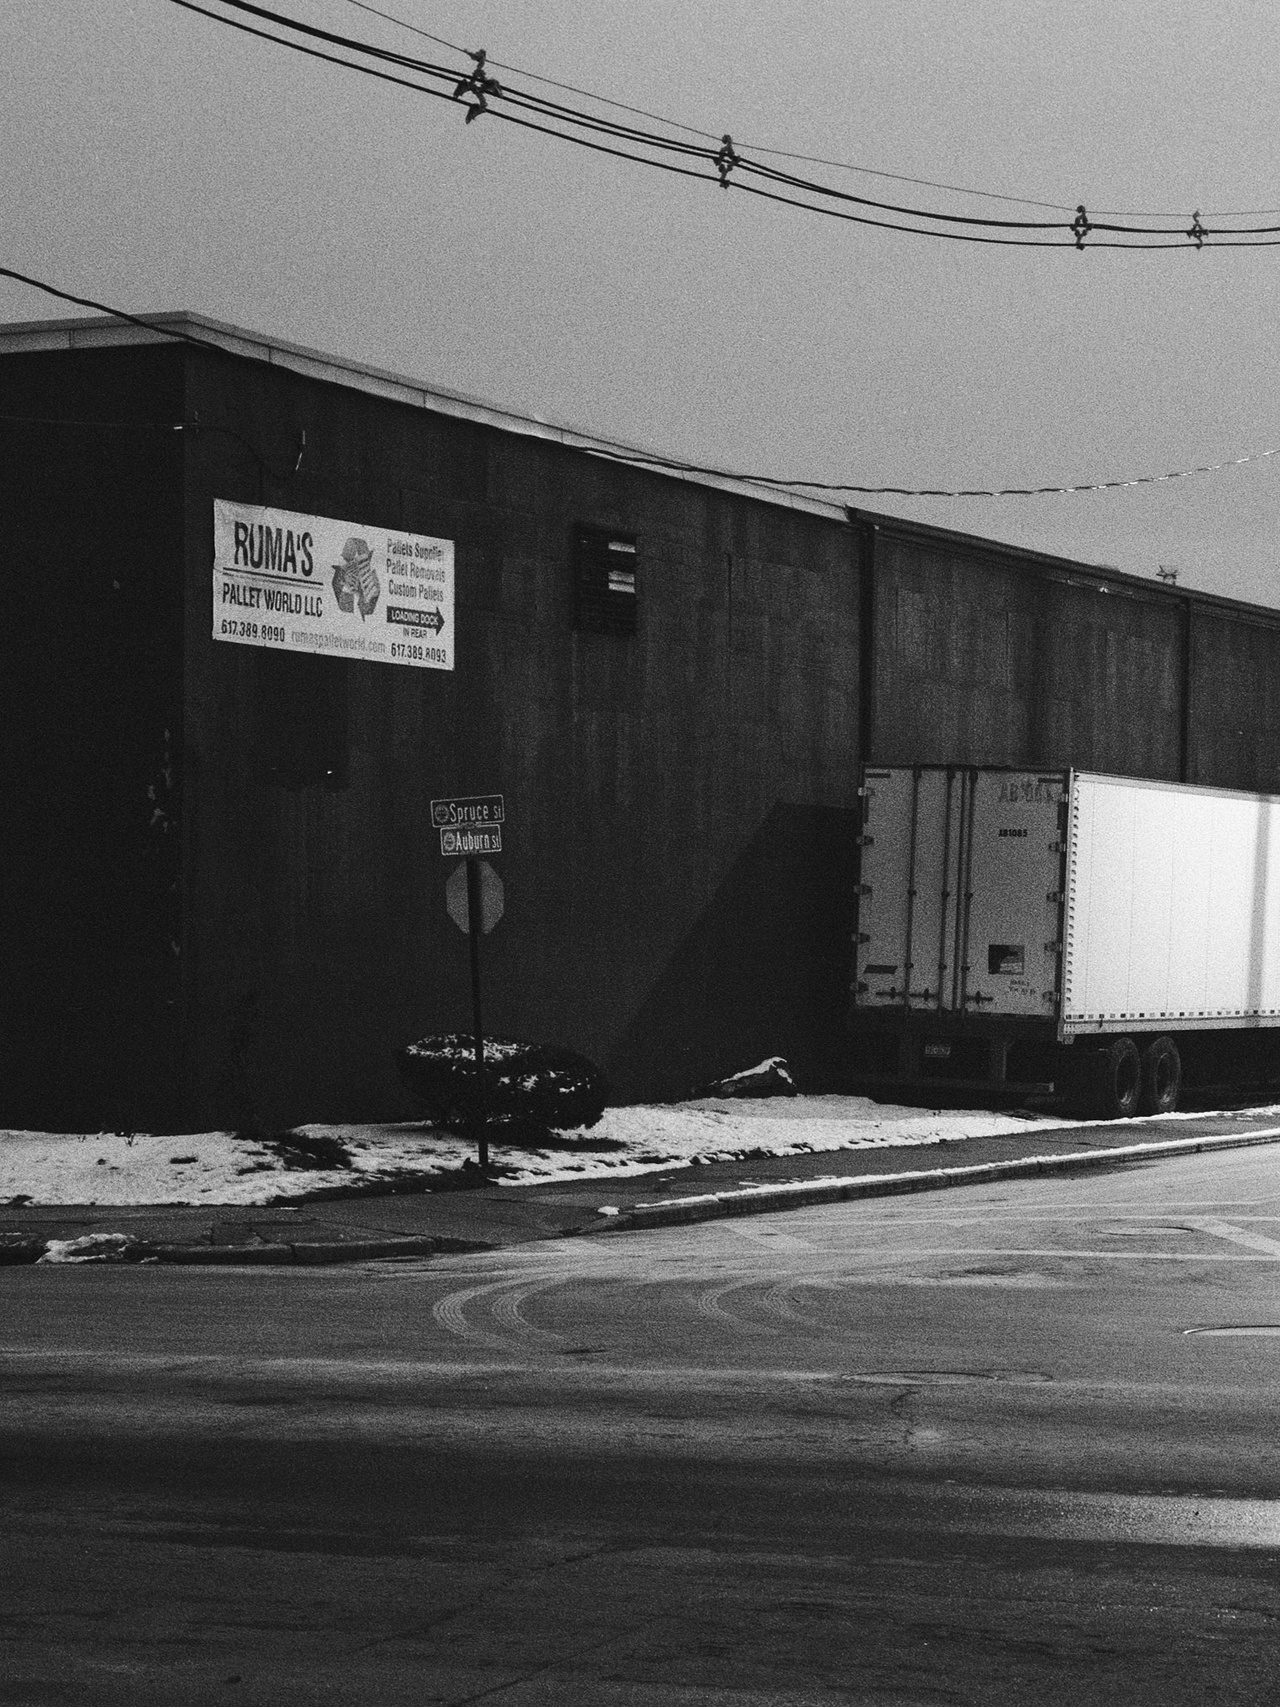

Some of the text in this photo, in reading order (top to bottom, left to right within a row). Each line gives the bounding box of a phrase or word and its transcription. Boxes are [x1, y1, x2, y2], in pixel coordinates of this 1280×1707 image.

[234, 520, 314, 577] RUMA'S
[387, 538, 413, 558] Pallets
[386, 558, 446, 583] Pallet Removals
[222, 583, 323, 618] PALLET WORLD LLC
[388, 579, 444, 602] Custom Pallets
[391, 609, 439, 626] LOADING DOCK
[221, 619, 286, 643] 617.389.8090
[403, 627, 428, 639] IN REAR
[449, 803, 489, 824] Spruce
[456, 831, 490, 851] Auburn
